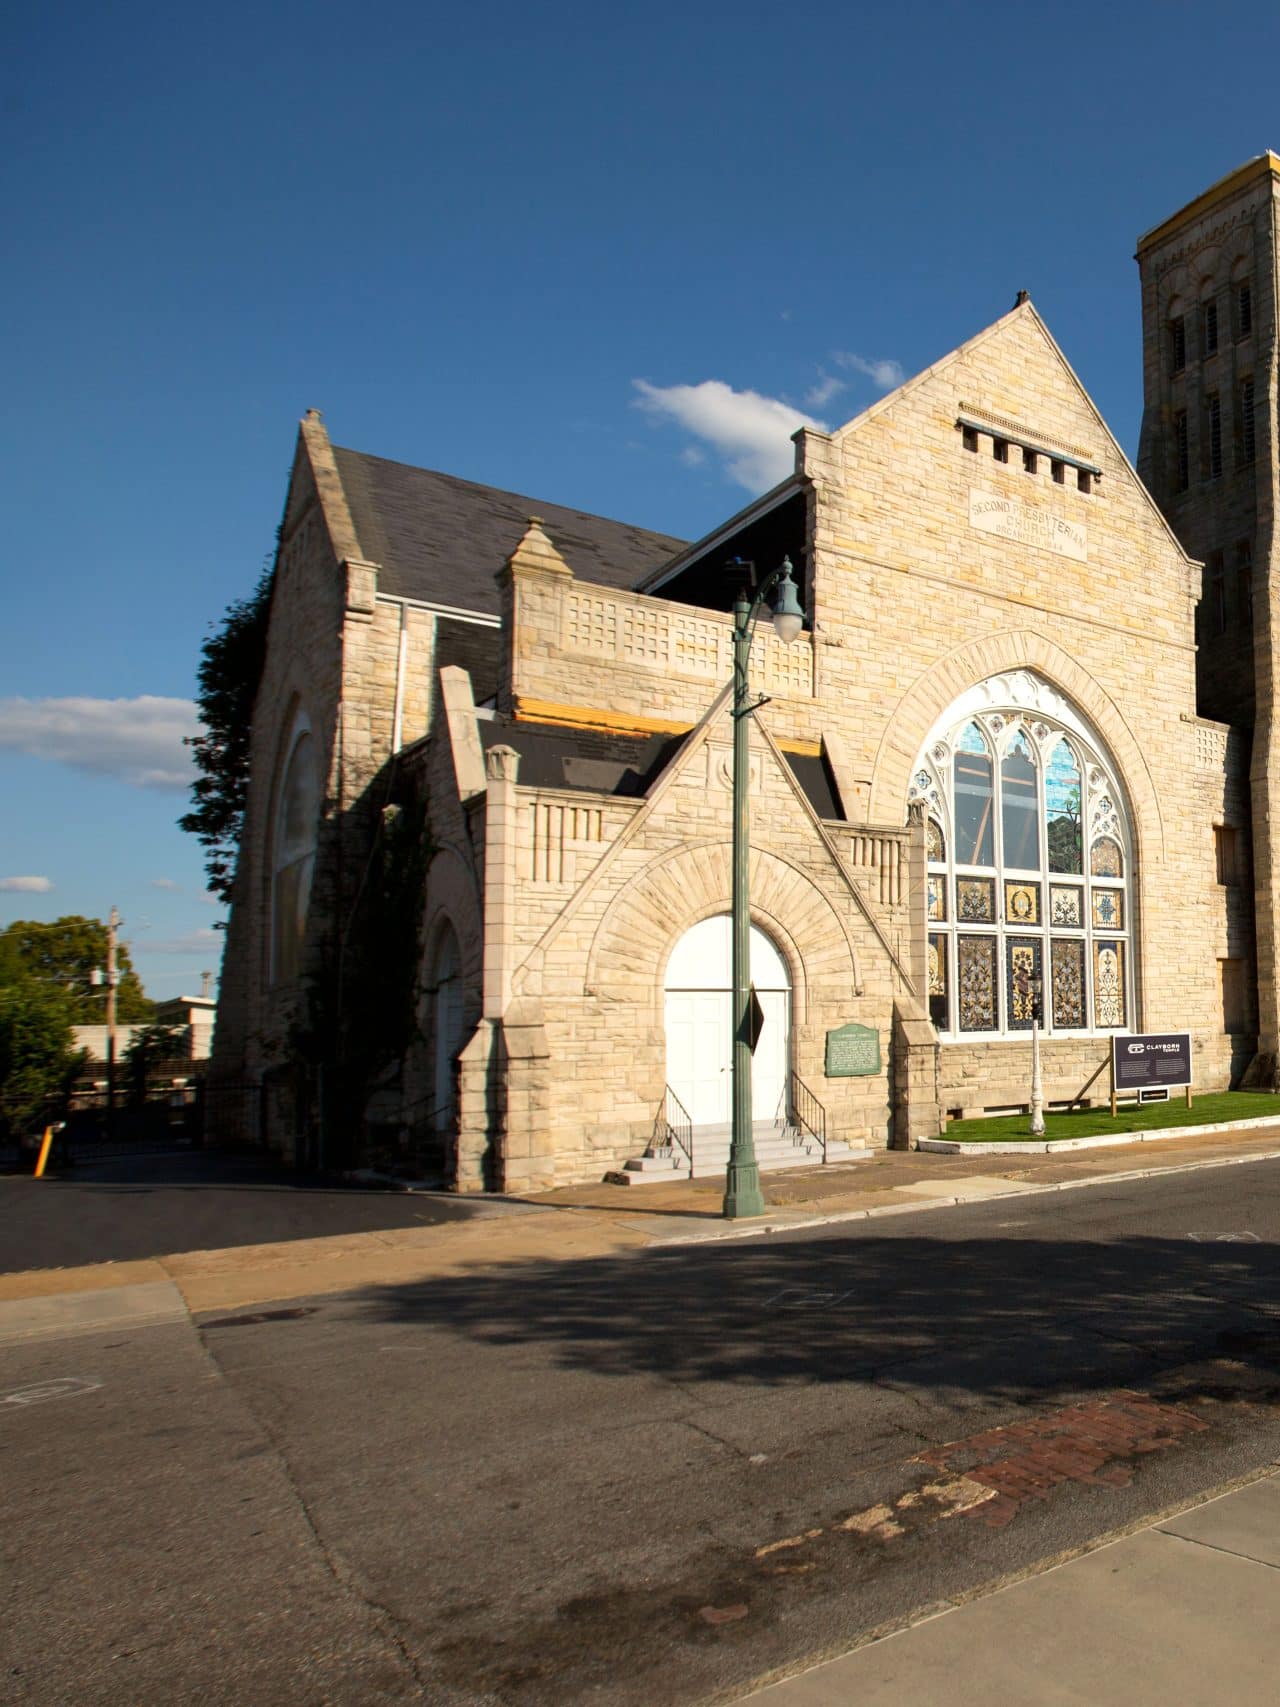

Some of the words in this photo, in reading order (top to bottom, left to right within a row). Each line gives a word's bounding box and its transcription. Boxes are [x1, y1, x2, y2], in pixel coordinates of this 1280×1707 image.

[972, 500, 1010, 515] SECOND
[1012, 503, 1086, 548] PRESBYTERIAN
[1006, 515, 1055, 541] CHURCH
